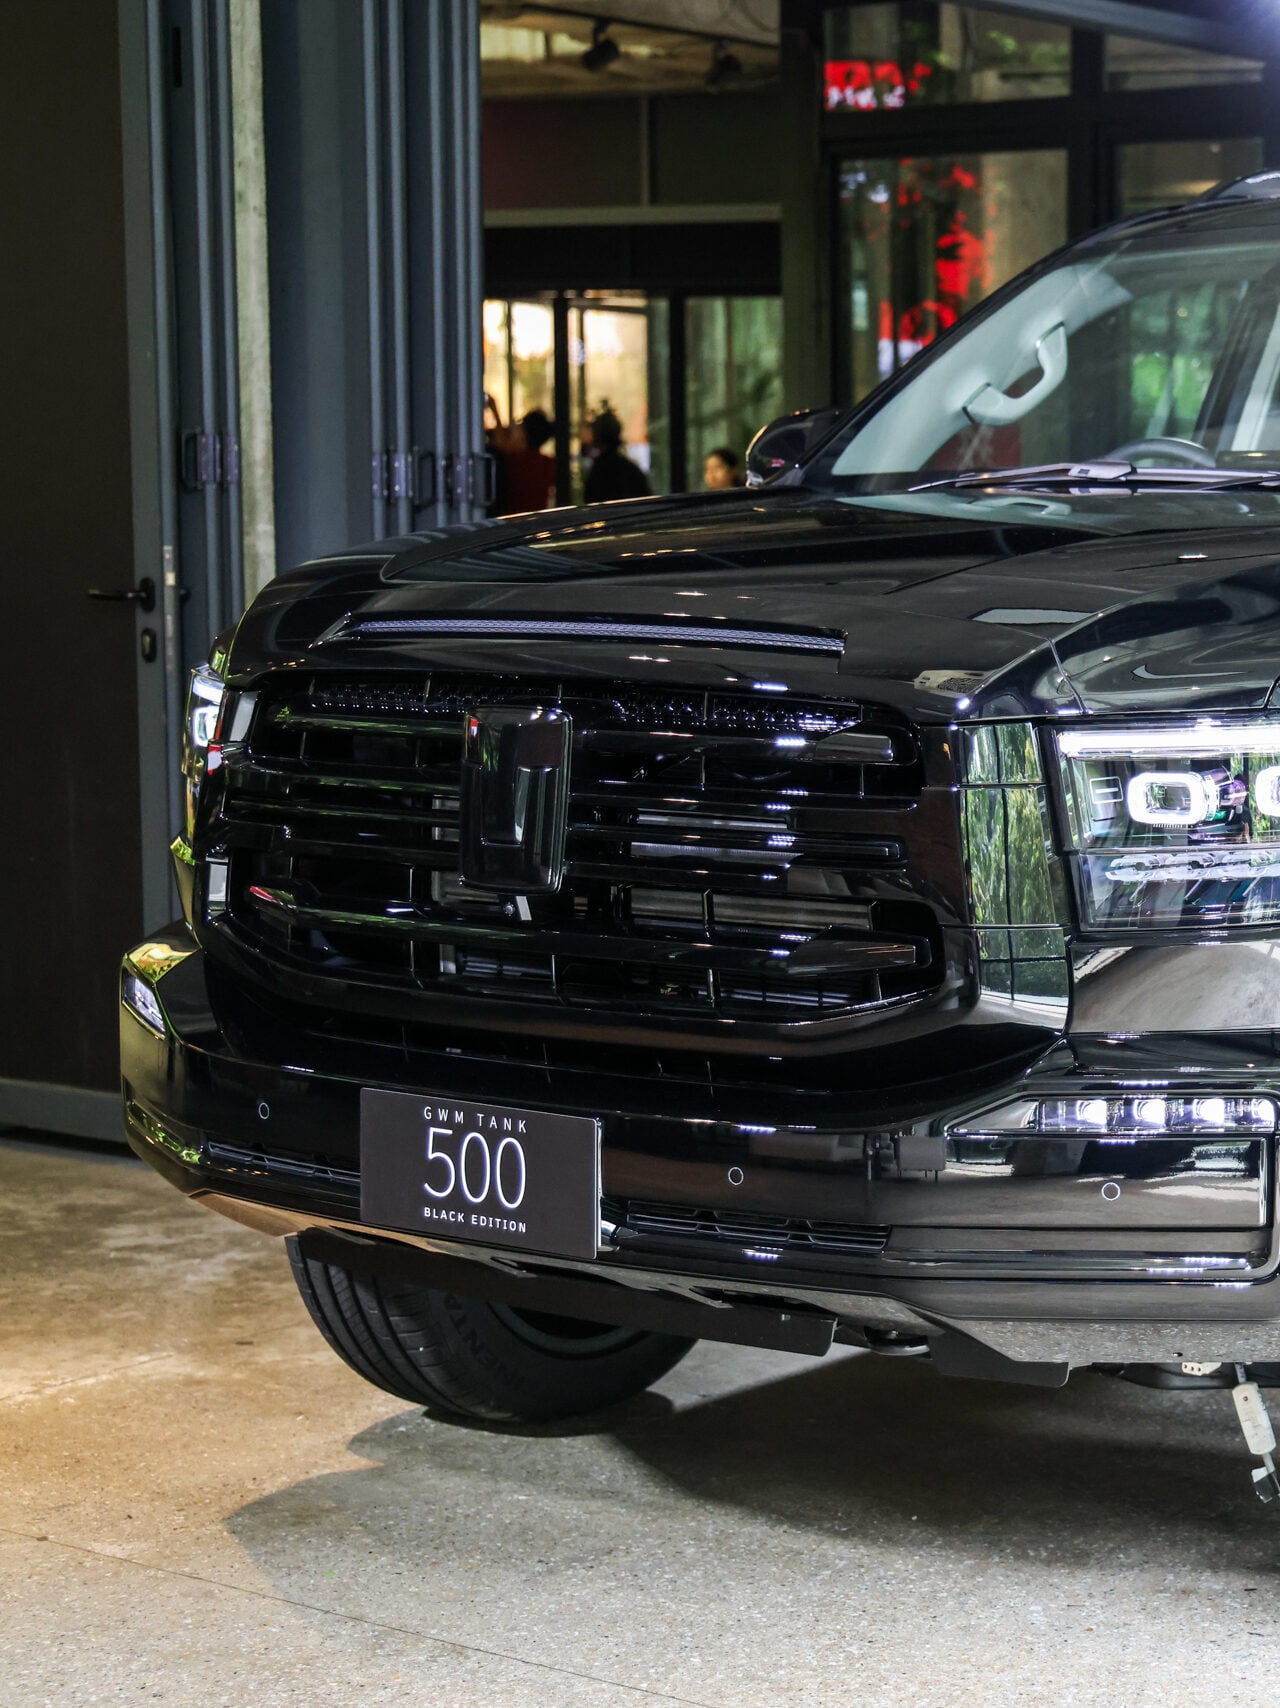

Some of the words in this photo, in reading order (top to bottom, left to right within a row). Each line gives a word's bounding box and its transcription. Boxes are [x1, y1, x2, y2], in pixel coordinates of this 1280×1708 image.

[424, 1106, 464, 1124] GWM
[477, 1113, 527, 1133] TANK
[424, 1127, 526, 1209] 500
[424, 1207, 465, 1223] BLACK
[471, 1214, 527, 1233] EDITION
